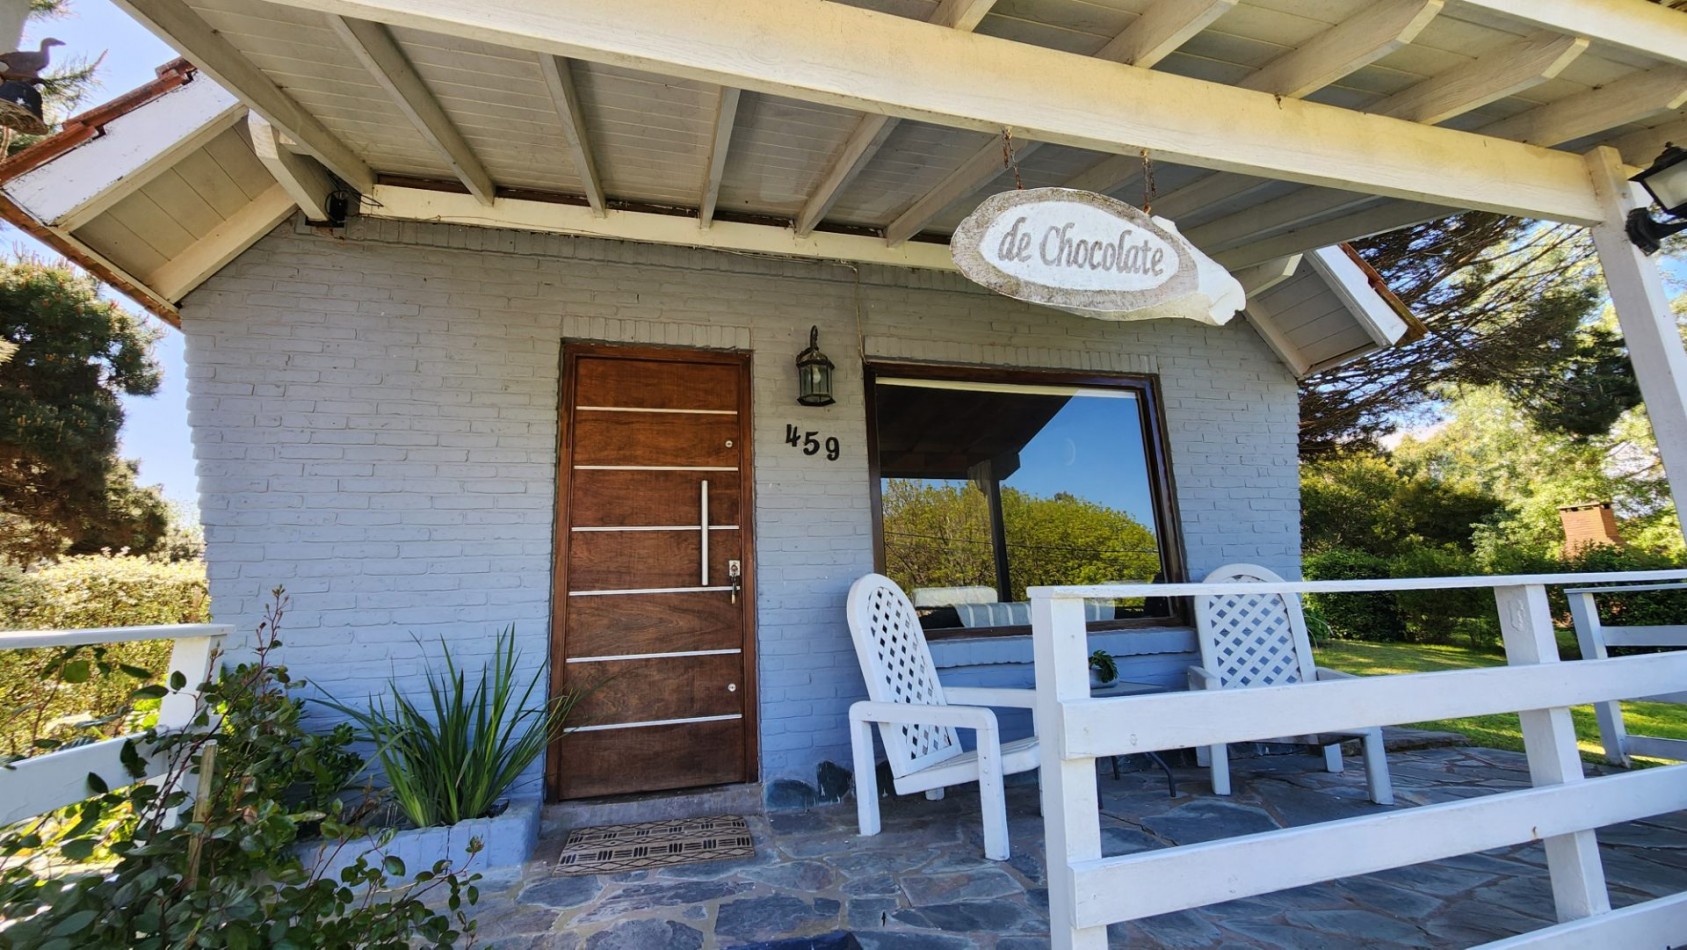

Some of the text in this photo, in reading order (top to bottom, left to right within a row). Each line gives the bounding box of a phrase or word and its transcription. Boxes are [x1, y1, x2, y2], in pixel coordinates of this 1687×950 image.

[997, 216, 1164, 276] de Chocolate
[785, 423, 840, 461] 459
